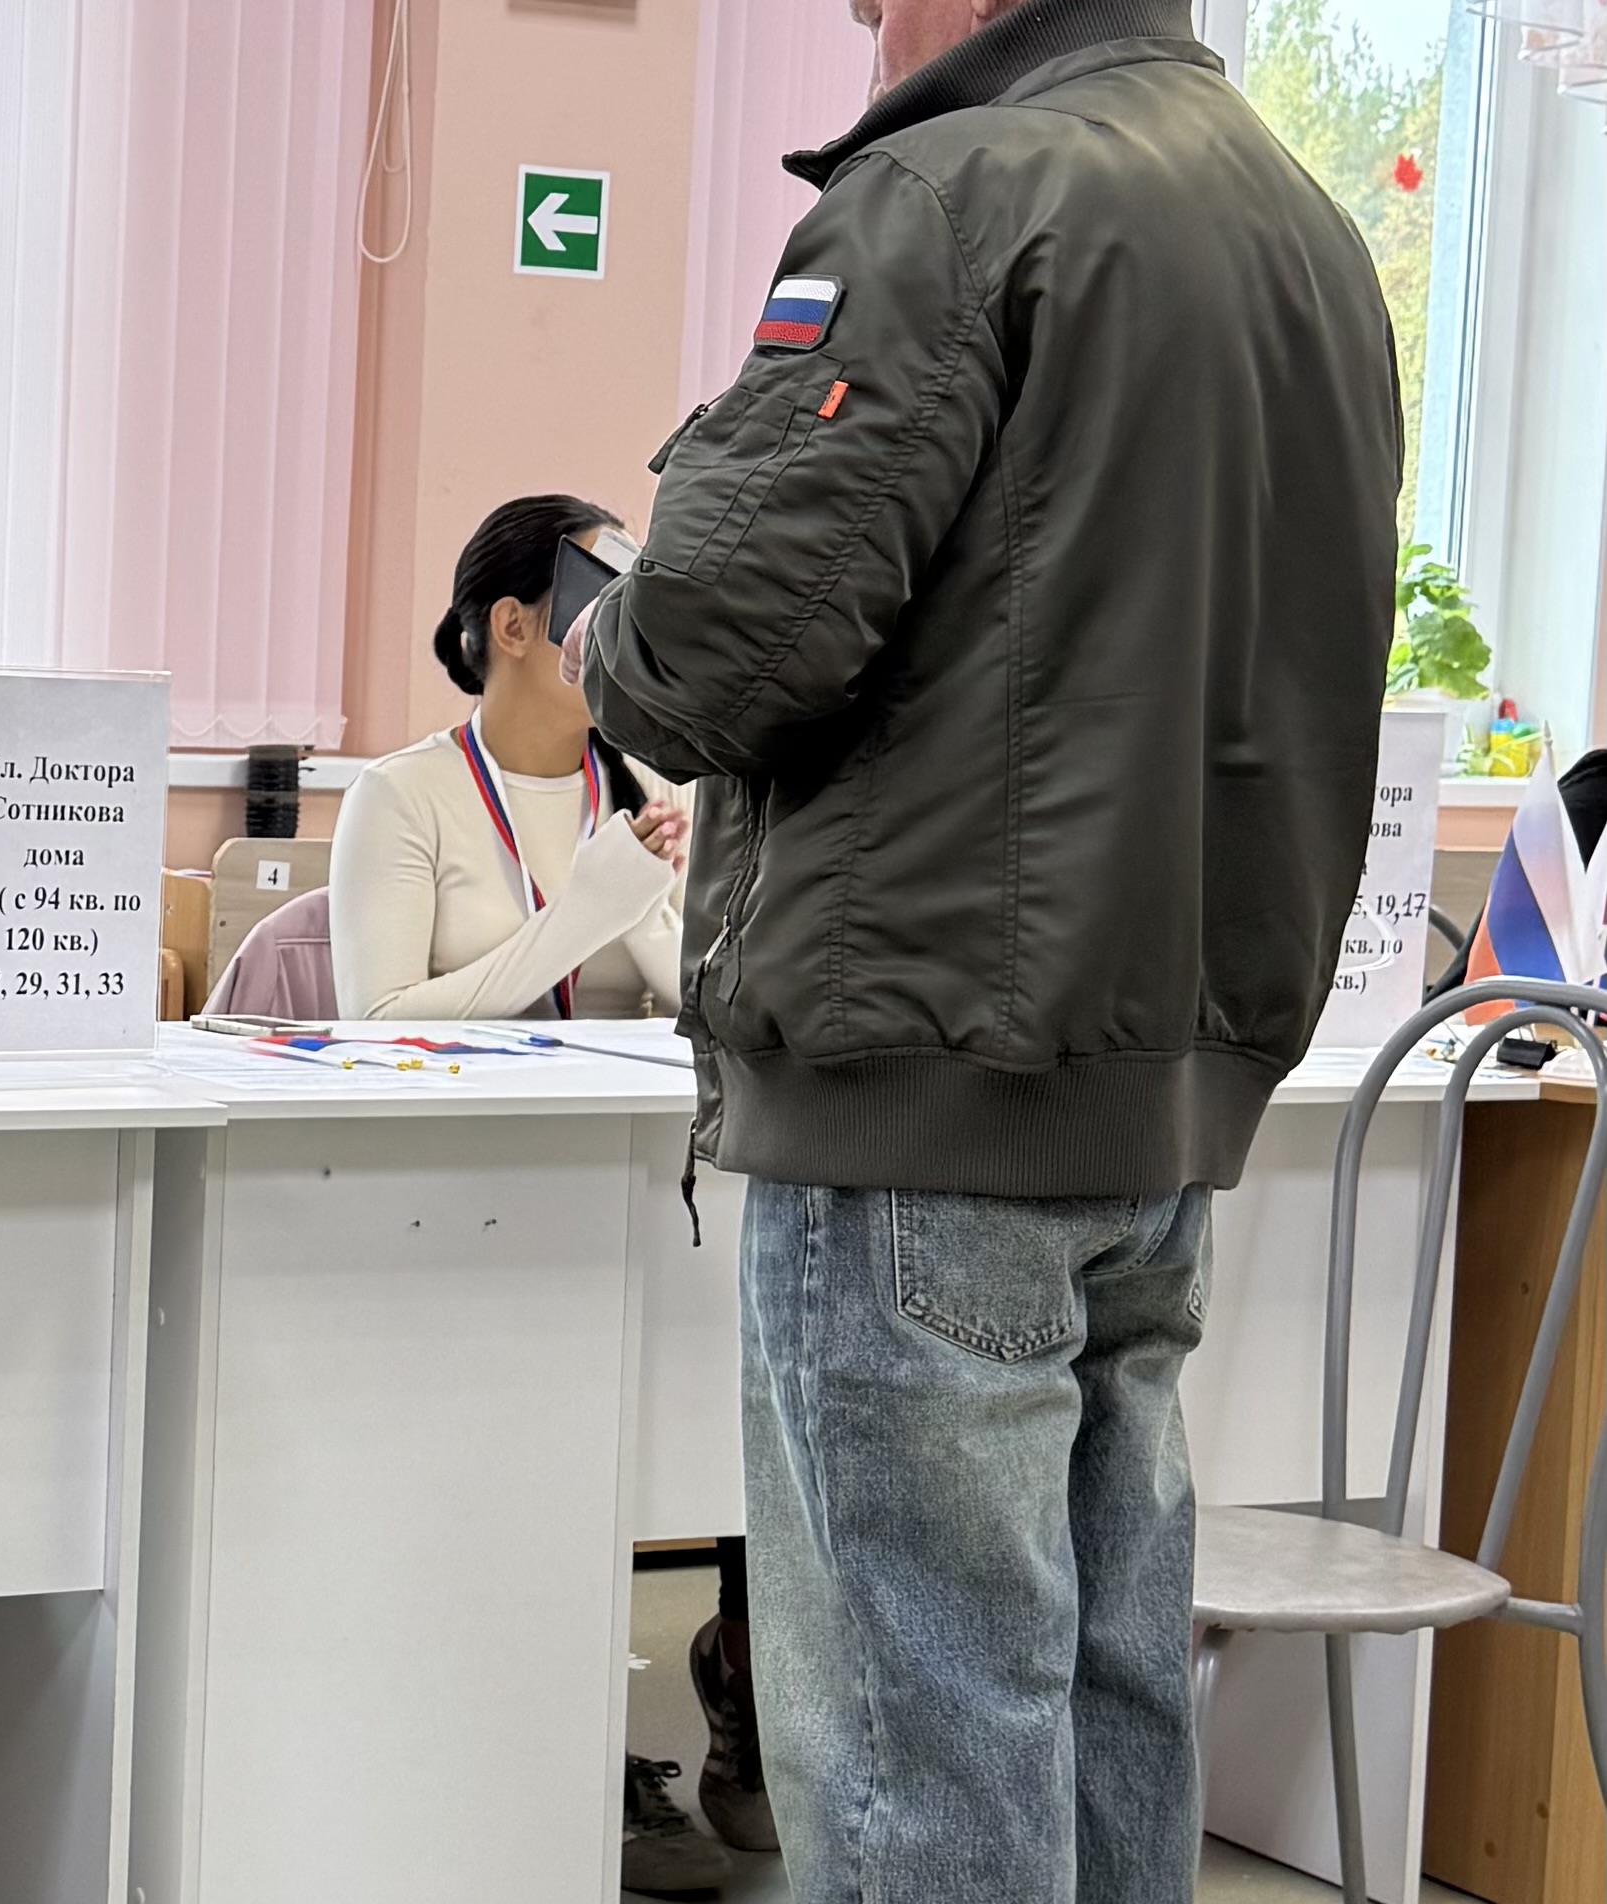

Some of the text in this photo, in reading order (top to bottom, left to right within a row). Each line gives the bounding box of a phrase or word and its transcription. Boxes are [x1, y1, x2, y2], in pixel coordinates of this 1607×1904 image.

[29, 756, 135, 789] Доктора
[23, 848, 84, 868] дома
[267, 867, 278, 886] 4
[34, 886, 60, 910] 94
[69, 894, 105, 911] кв.
[113, 894, 141, 912] по
[6, 927, 99, 957] 120 кв.)
[15, 972, 49, 999] 29,
[56, 972, 91, 999] 31,
[97, 972, 124, 996] 33
